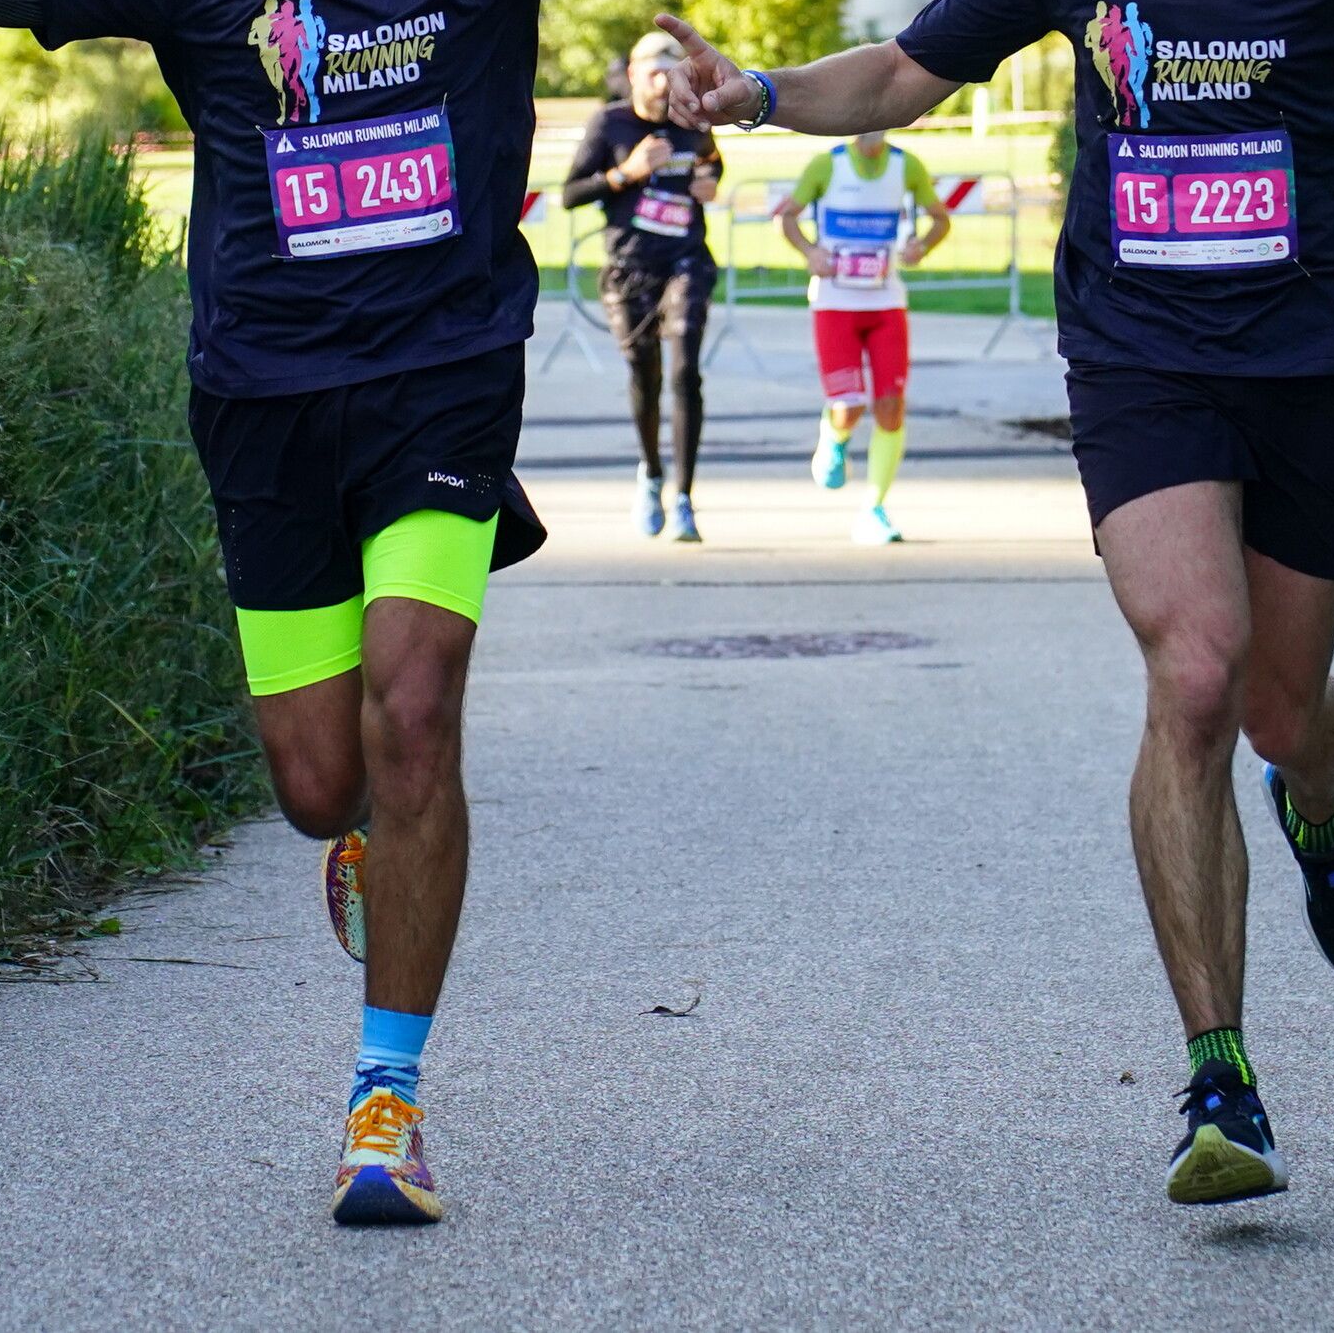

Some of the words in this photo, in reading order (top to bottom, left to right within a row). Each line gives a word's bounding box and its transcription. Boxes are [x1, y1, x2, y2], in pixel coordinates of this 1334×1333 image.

[327, 11, 446, 52] SALOMON
[324, 35, 436, 78] RUNNING
[1155, 39, 1286, 60] SALOMON
[322, 62, 421, 95] MILANO
[1152, 58, 1272, 84] RUNNING
[1151, 81, 1252, 102] MILANO
[301, 130, 354, 150] SALOMON
[355, 123, 403, 143] RUNNING
[403, 114, 440, 136] MILANO
[1139, 144, 1189, 159] SALOMON
[1190, 141, 1239, 157] RUNNING
[1240, 139, 1282, 155] MILANO
[285, 171, 329, 217] 15
[356, 154, 437, 208] 2431
[1121, 180, 1158, 225] 15
[1188, 177, 1275, 224] 2223
[291, 239, 330, 249] SALOMON
[1122, 247, 1158, 256] SALOMON
